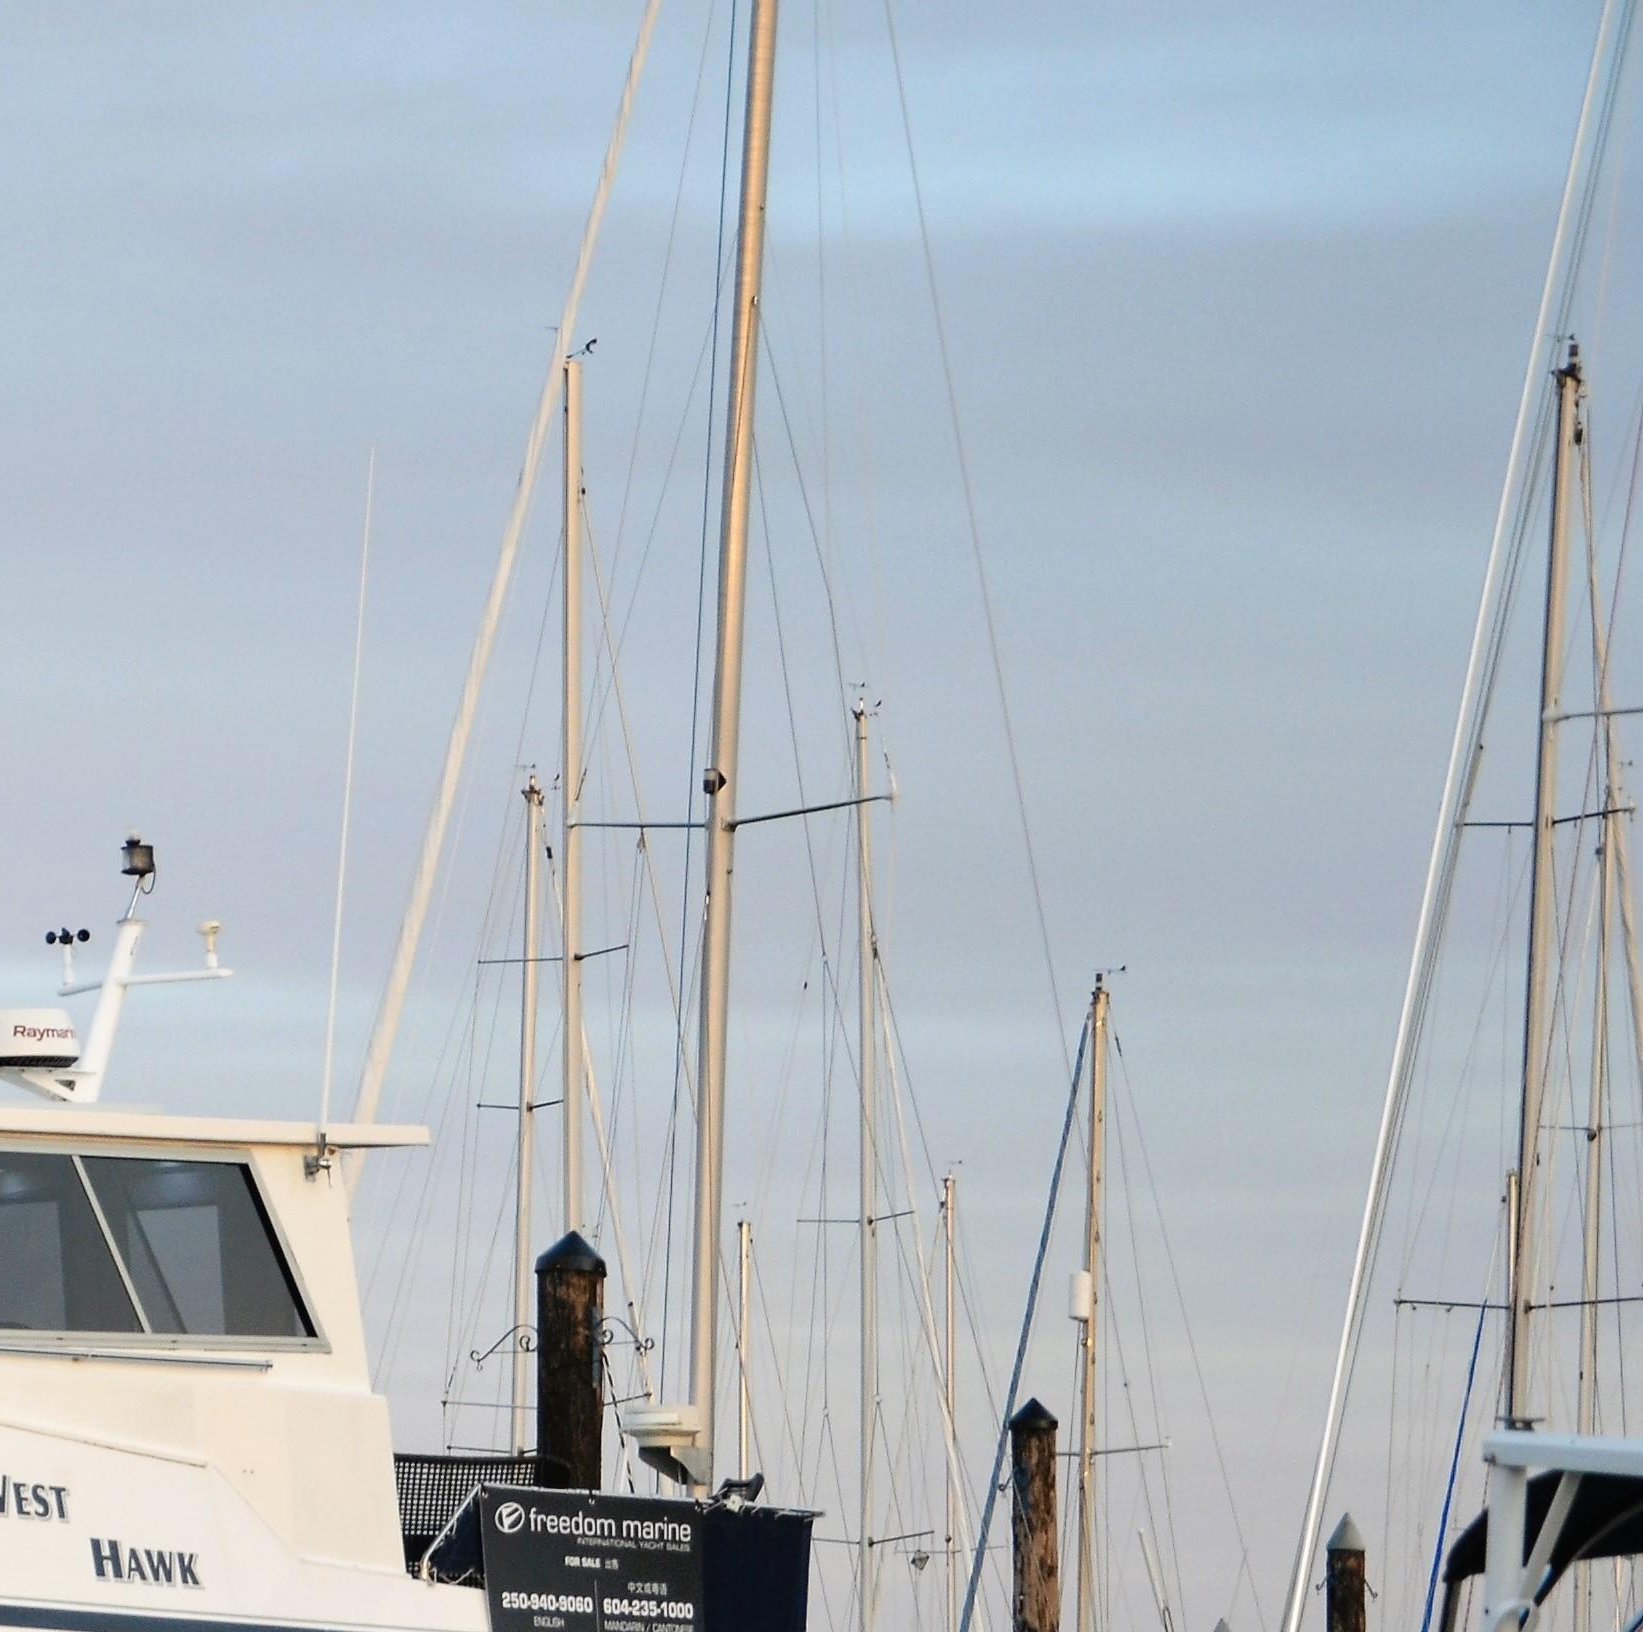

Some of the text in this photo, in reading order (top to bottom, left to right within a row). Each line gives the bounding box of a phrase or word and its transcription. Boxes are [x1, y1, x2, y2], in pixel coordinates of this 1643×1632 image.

[529, 1507, 691, 1542] freedom marine
[577, 1537, 691, 1552] INTERNATIONAL YACHT SALES
[565, 1556, 580, 1567] FOR
[582, 1557, 601, 1569] SALE
[502, 1591, 593, 1613] 250-940-9060
[603, 1597, 694, 1620] 604-235-1000
[533, 1615, 565, 1629] ENGLISH
